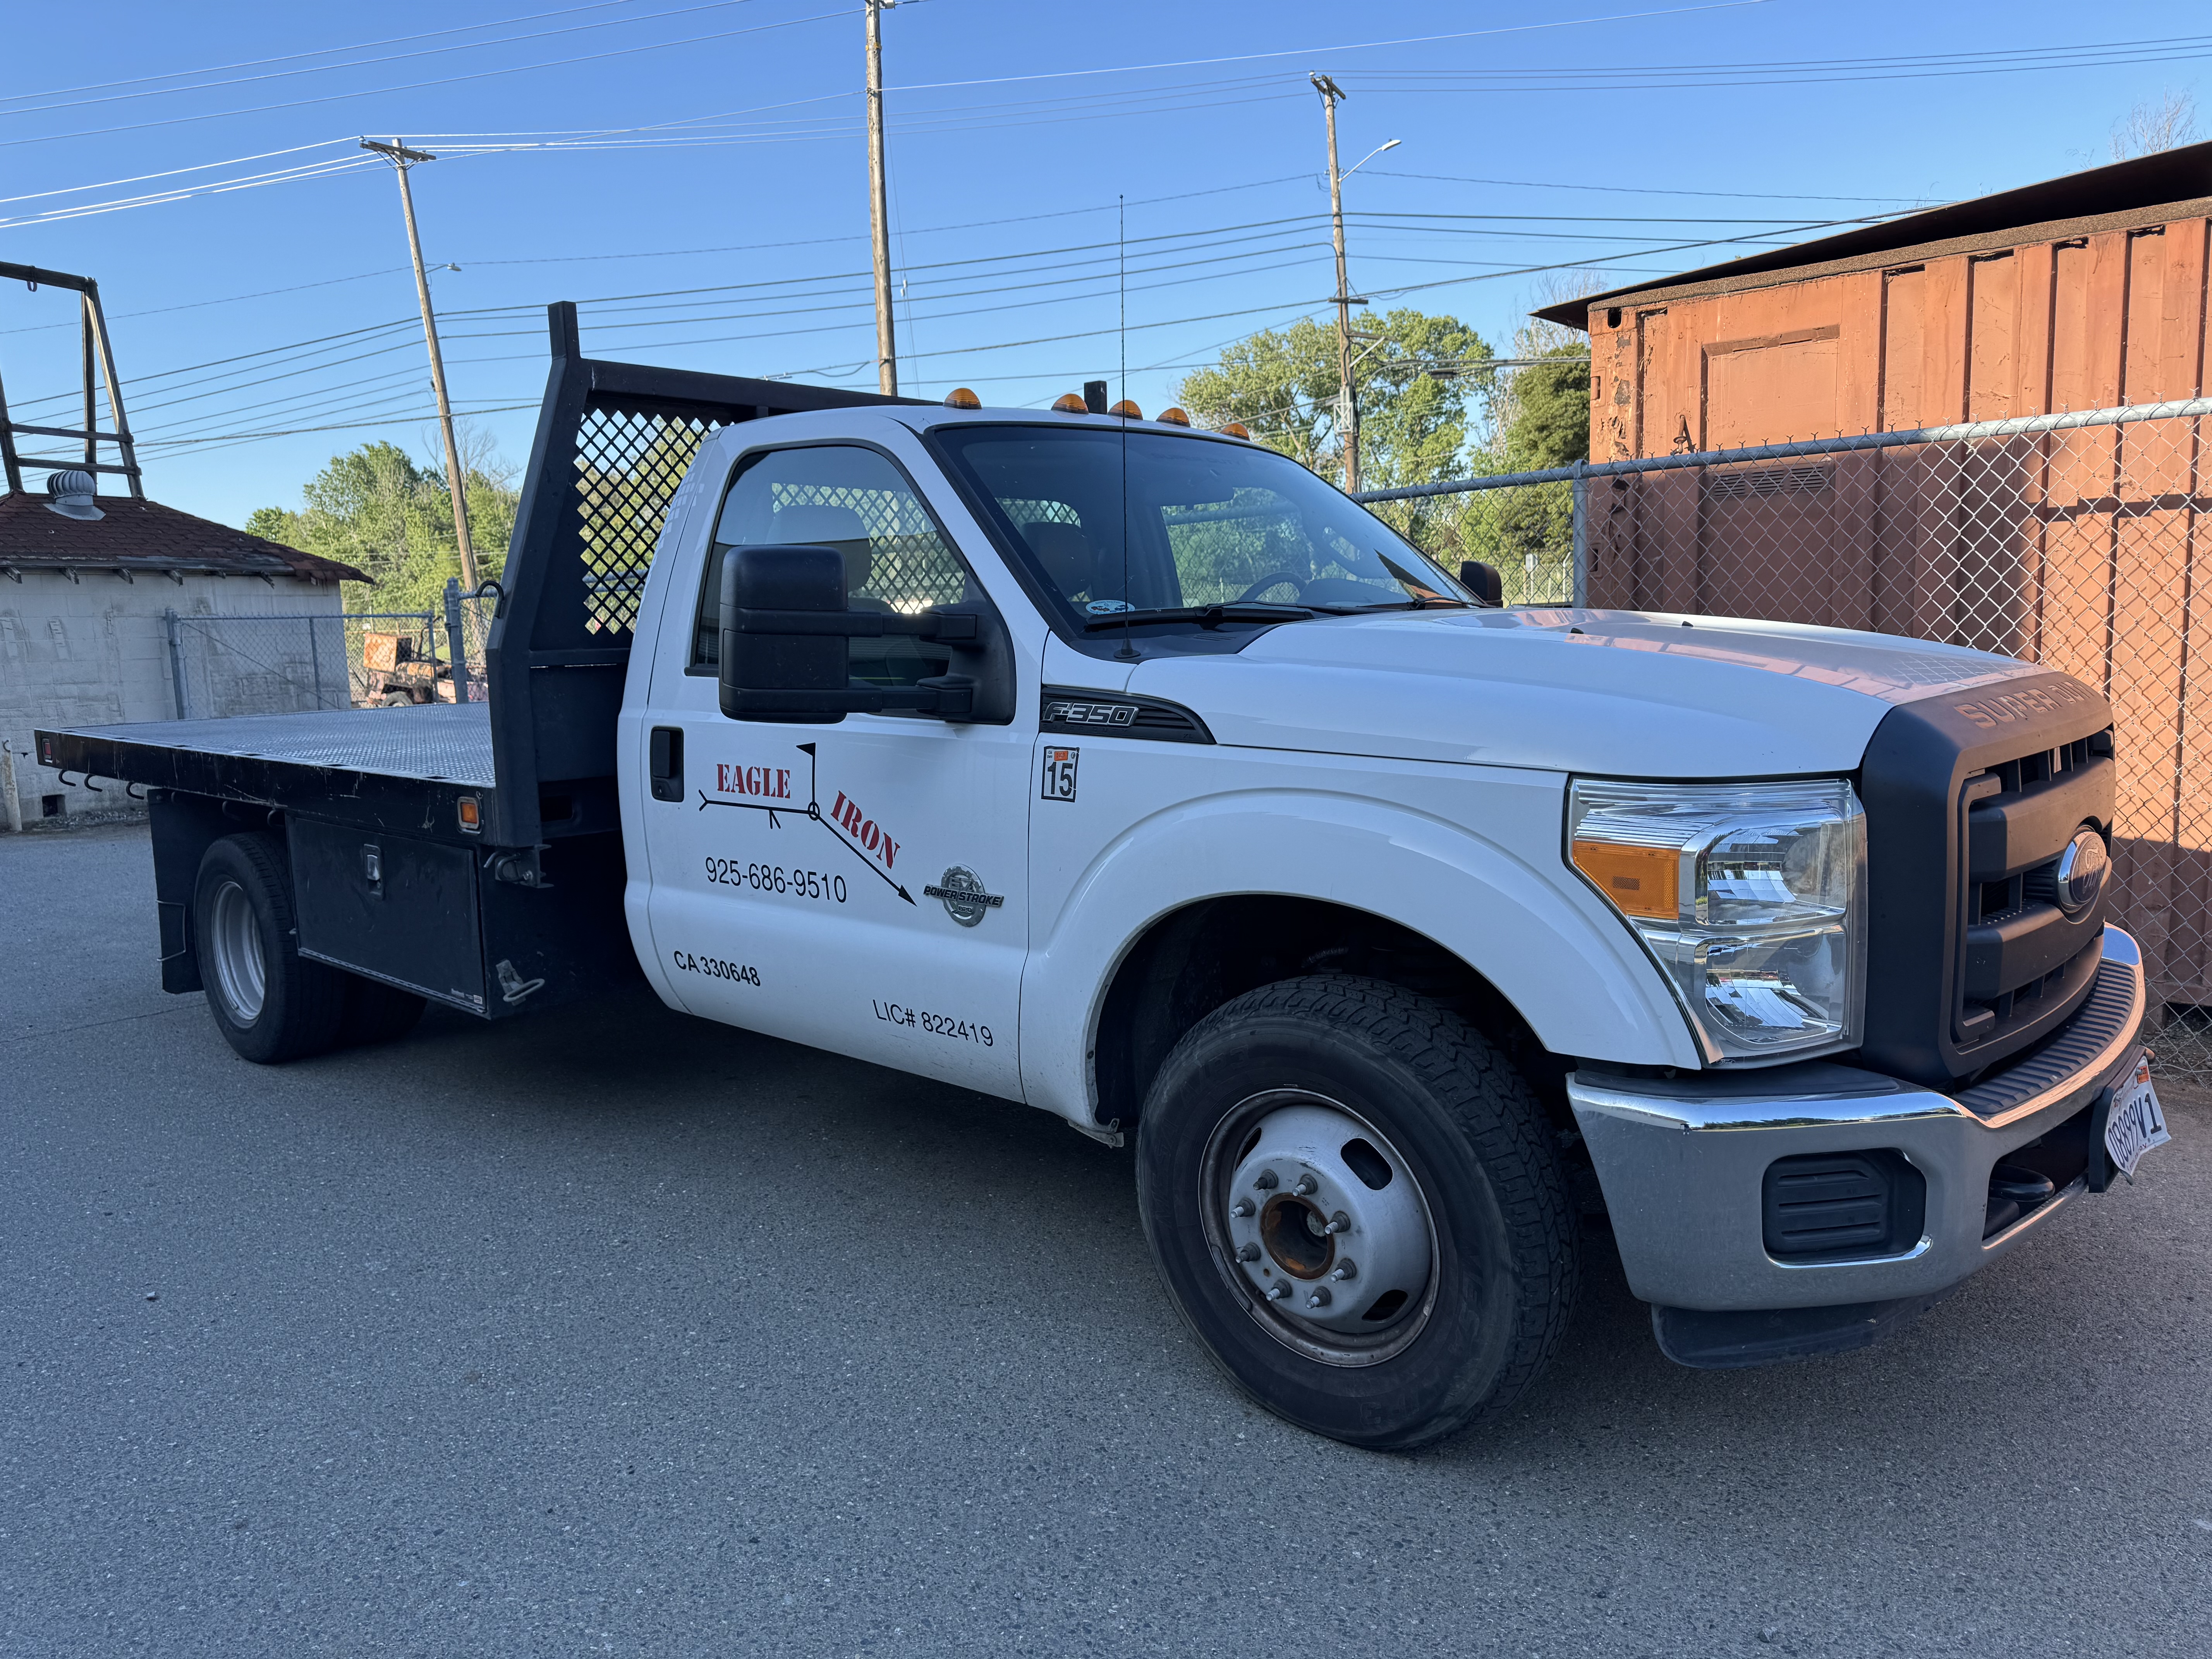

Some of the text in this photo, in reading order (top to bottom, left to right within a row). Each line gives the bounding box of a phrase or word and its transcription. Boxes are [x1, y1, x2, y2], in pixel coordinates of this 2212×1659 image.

[1954, 689, 2063, 728] SUPER
[717, 764, 791, 799] EAGLE
[1048, 761, 1073, 797] 15
[830, 790, 900, 869] IRON
[706, 857, 847, 903] 925-686-9510
[923, 885, 1001, 906] POWER STROKE
[872, 999, 993, 1047] LIC# 822419
[2108, 1092, 2162, 1168] 08899V1
